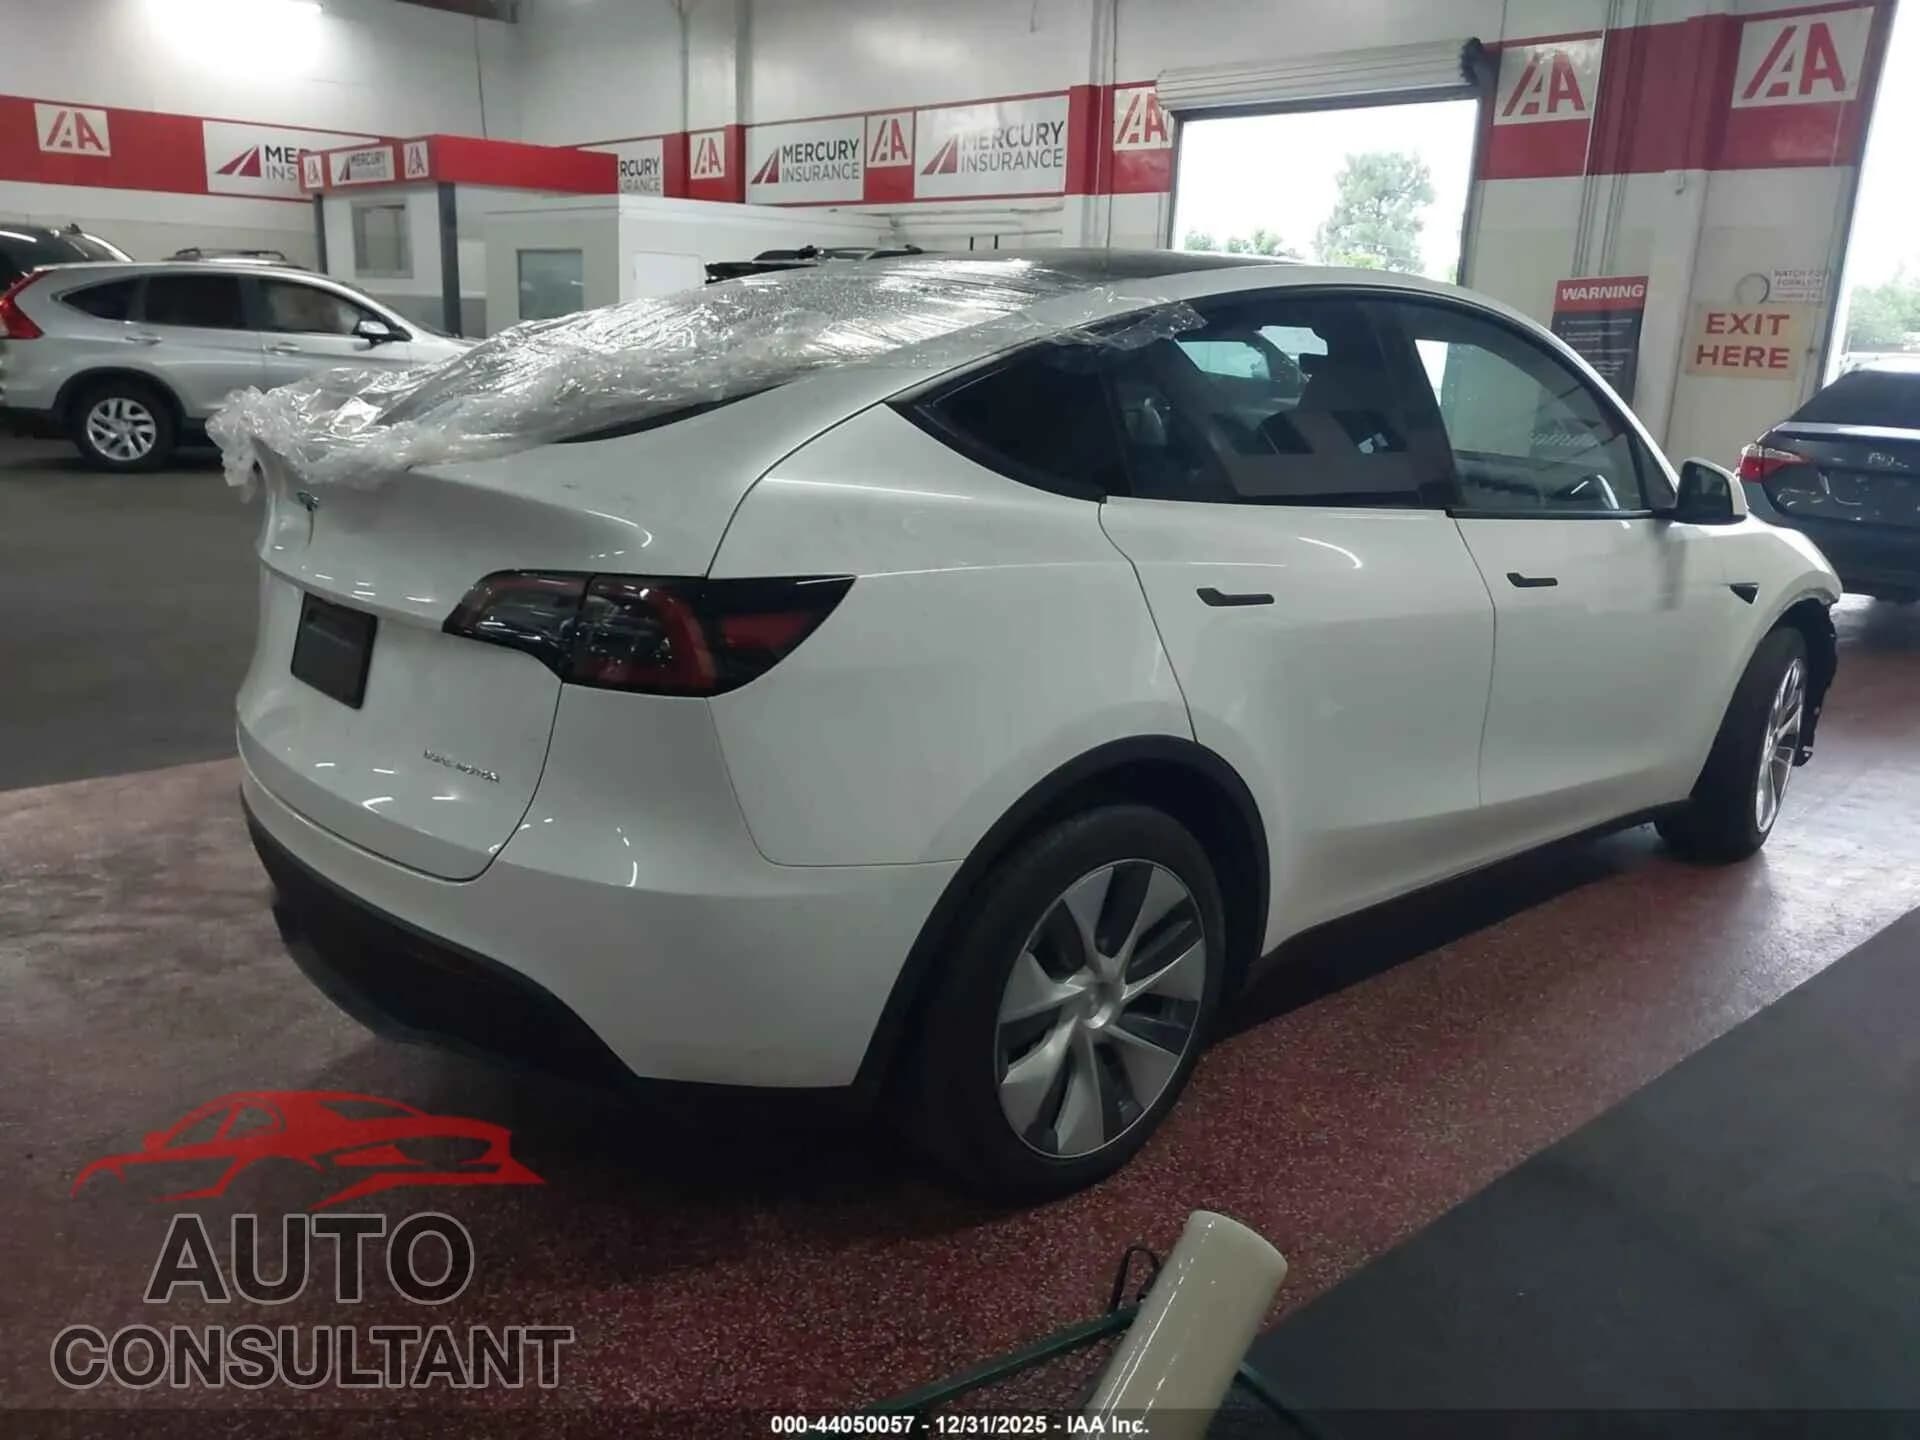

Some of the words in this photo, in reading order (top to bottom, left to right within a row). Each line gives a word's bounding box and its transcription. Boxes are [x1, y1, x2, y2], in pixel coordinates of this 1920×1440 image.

[962, 121, 1065, 150] MERCURY
[782, 138, 859, 163] MERCURY
[961, 149, 1063, 174] INSURANCE
[782, 162, 860, 183] INSURANCE
[1562, 284, 1645, 300] WARNING
[1705, 312, 1790, 336] EXIT
[1696, 344, 1790, 368] HERE
